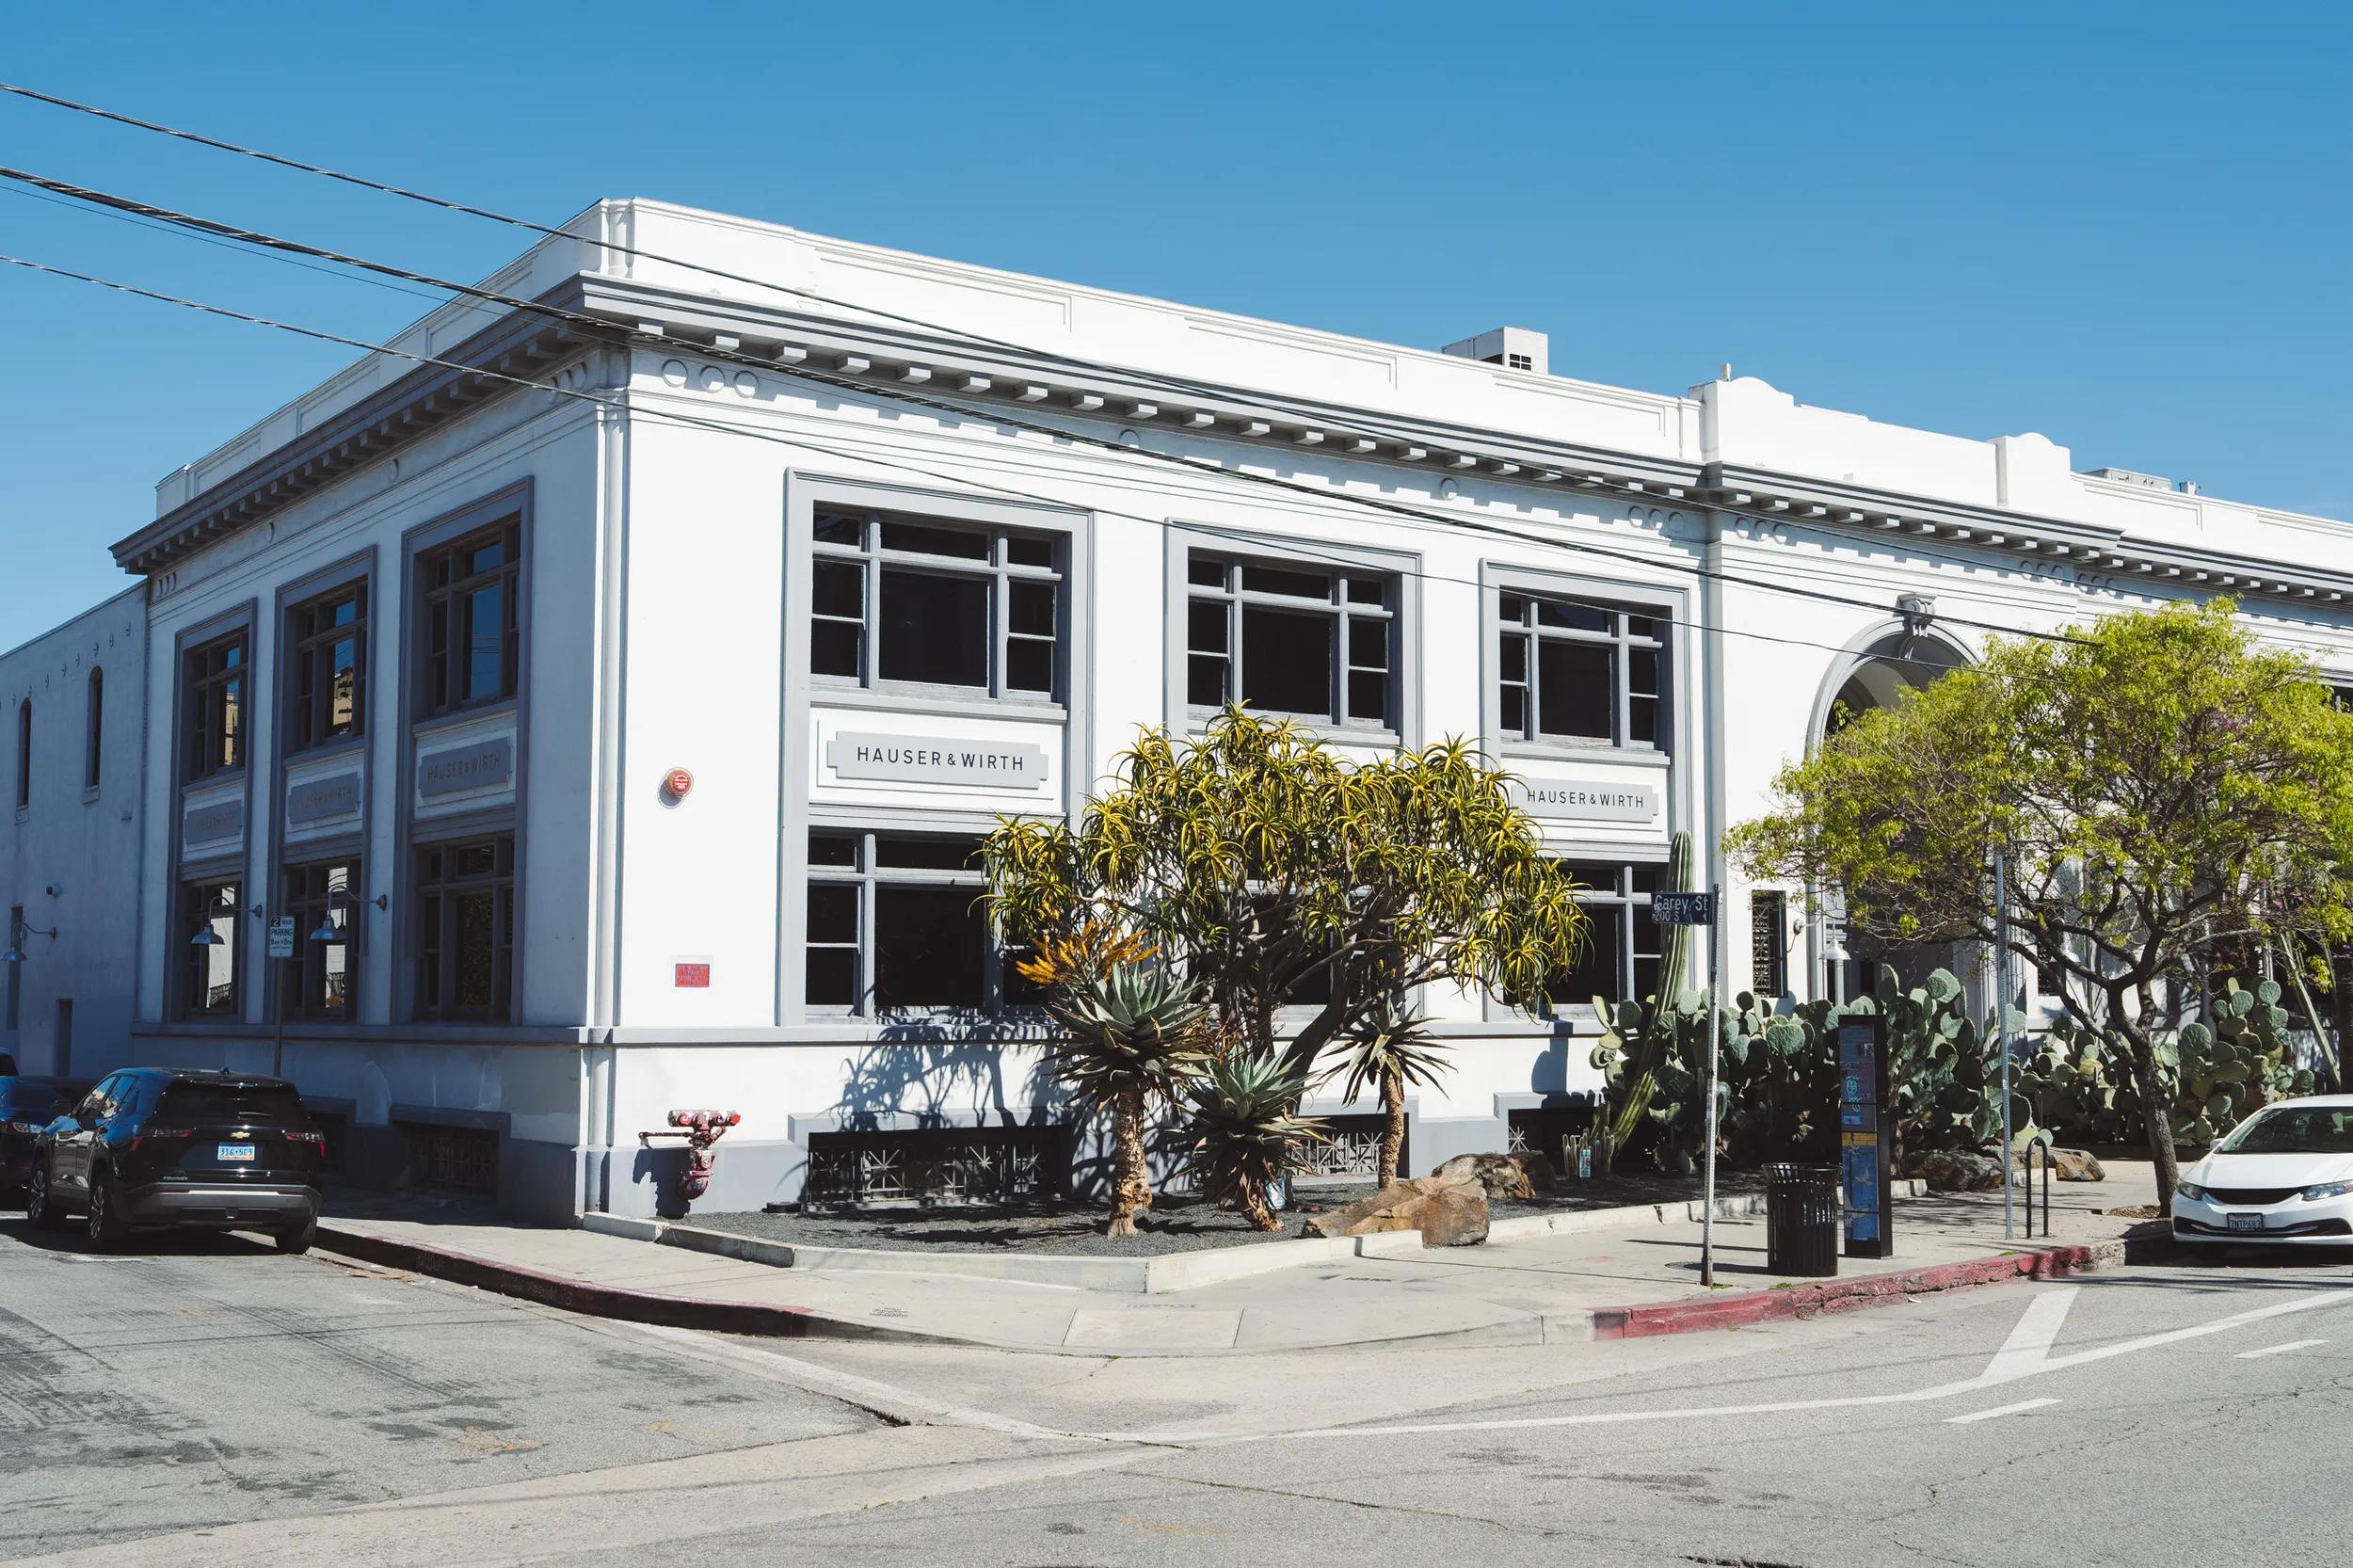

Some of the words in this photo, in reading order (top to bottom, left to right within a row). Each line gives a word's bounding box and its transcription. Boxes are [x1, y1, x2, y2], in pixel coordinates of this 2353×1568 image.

[857, 746, 1023, 771] HAUSER&WIRTH
[1655, 894, 1689, 914] Carey
[1695, 895, 1708, 911] St
[1655, 910, 1671, 921] 200
[1674, 910, 1680, 921] S
[273, 918, 279, 926] 2
[271, 928, 293, 936] PARKING
